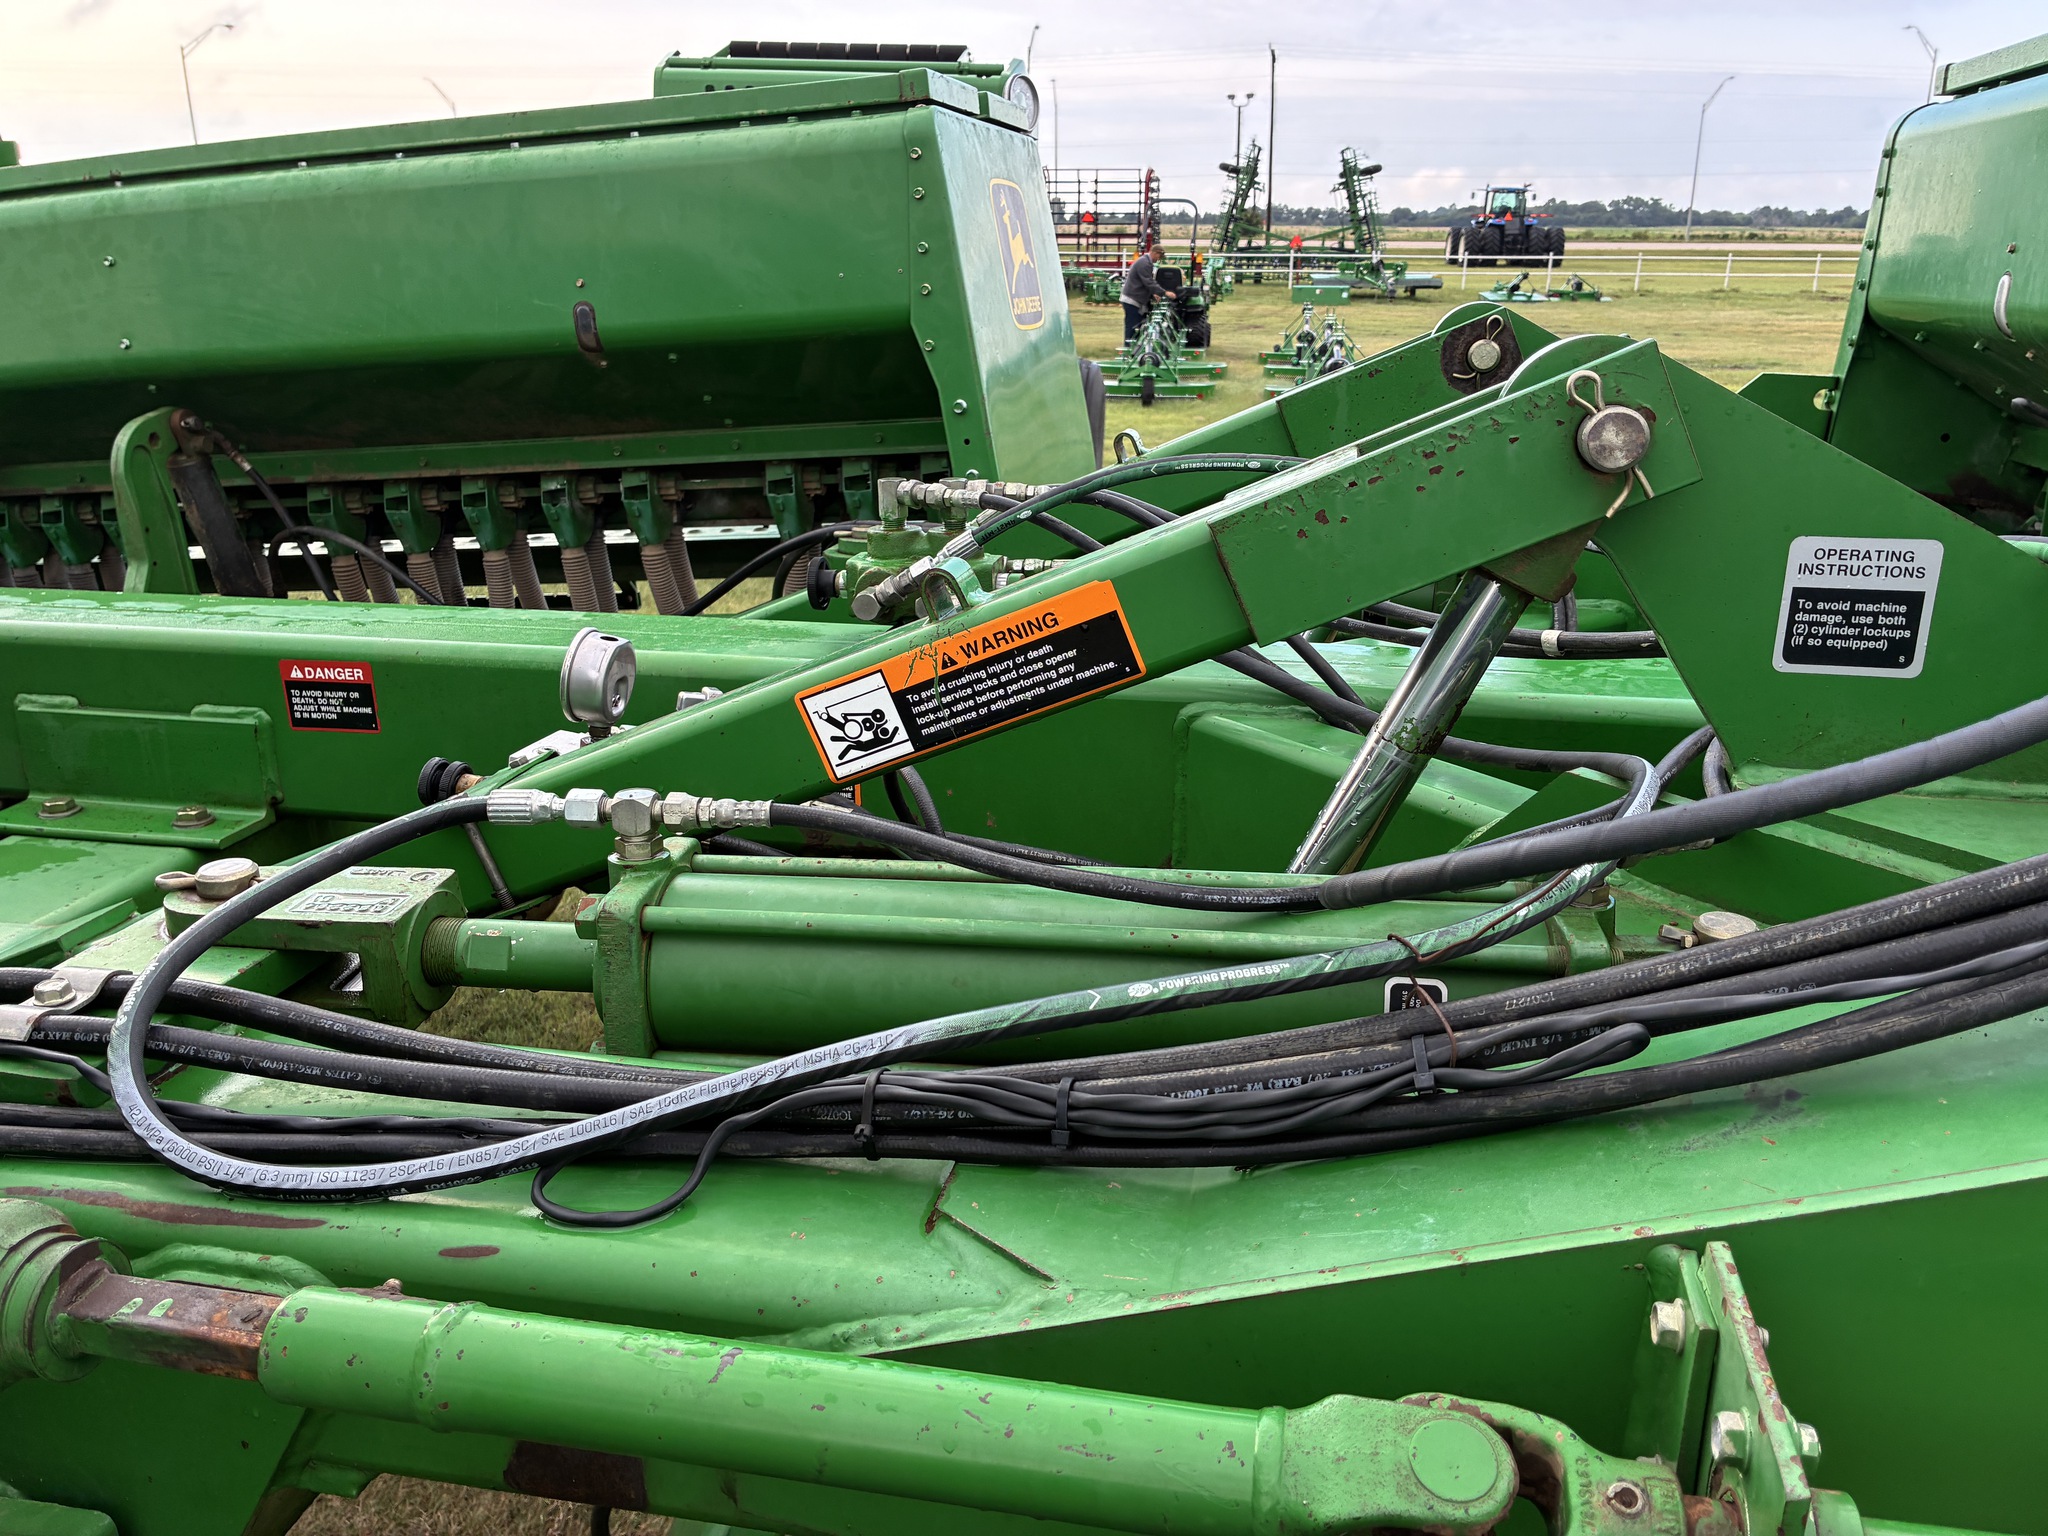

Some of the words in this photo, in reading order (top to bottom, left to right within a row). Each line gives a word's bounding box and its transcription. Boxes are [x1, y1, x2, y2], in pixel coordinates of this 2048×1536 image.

[1012, 297, 1027, 315] JOHN
[1026, 296, 1041, 313] DEERE
[1814, 548, 1915, 562] OPERATING
[1798, 563, 1926, 578] INSTRUCTIONS
[1798, 599, 1812, 609] To
[1817, 601, 1850, 610] avoid
[1855, 602, 1907, 612] machine
[1795, 612, 1846, 624] damage,
[1851, 615, 1873, 624] use
[1878, 615, 1906, 625] both
[959, 611, 1060, 659] WARNING
[1793, 624, 1808, 635] (2)
[1811, 624, 1860, 636] cylinder
[1863, 626, 1911, 640] lockups
[1791, 636, 1804, 647] (if
[1808, 638, 1822, 646] so
[1826, 639, 1888, 651] equipped)
[304, 667, 364, 680] DANGER
[906, 694, 920, 704] To
[921, 684, 946, 700] avoid
[947, 668, 986, 690] crushing
[986, 660, 1014, 678] injury
[1016, 654, 1026, 664] or
[1026, 644, 1054, 659] death
[911, 700, 938, 715] install
[942, 687, 972, 704] service
[974, 676, 998, 694] locks
[1000, 670, 1018, 684] and
[1019, 662, 1044, 678] close
[1046, 649, 1078, 668] opener
[916, 709, 951, 726] lock-up
[951, 698, 976, 712] valve
[976, 686, 1006, 704] before
[1006, 669, 1058, 696] performing
[1058, 662, 1076, 676] any
[921, 710, 978, 736] maintenance
[978, 706, 990, 716] or
[990, 685, 1046, 712] adjustments
[1046, 676, 1074, 691] under
[1075, 662, 1118, 682] machine.
[342, 706, 372, 714] MACHINE
[1158, 972, 1219, 992] POWERING
[47, 1031, 71, 1040] MAX
[178, 1043, 196, 1054] 3/8
[324, 1068, 362, 1080] GATES
[128, 1104, 148, 1126] 42.0
[144, 1122, 165, 1145] MPa
[317, 1170, 339, 1184] ISO
[342, 1167, 384, 1183] 11237
[458, 1147, 500, 1167] EN857
[504, 1140, 530, 1157] 2SC
[541, 1130, 565, 1146] SAE
[569, 1114, 618, 1138] 100R16
[629, 1104, 654, 1120] SAE
[700, 1079, 737, 1098] Flame
[740, 1061, 800, 1086] Resistant
[803, 1046, 841, 1066] MSHA
